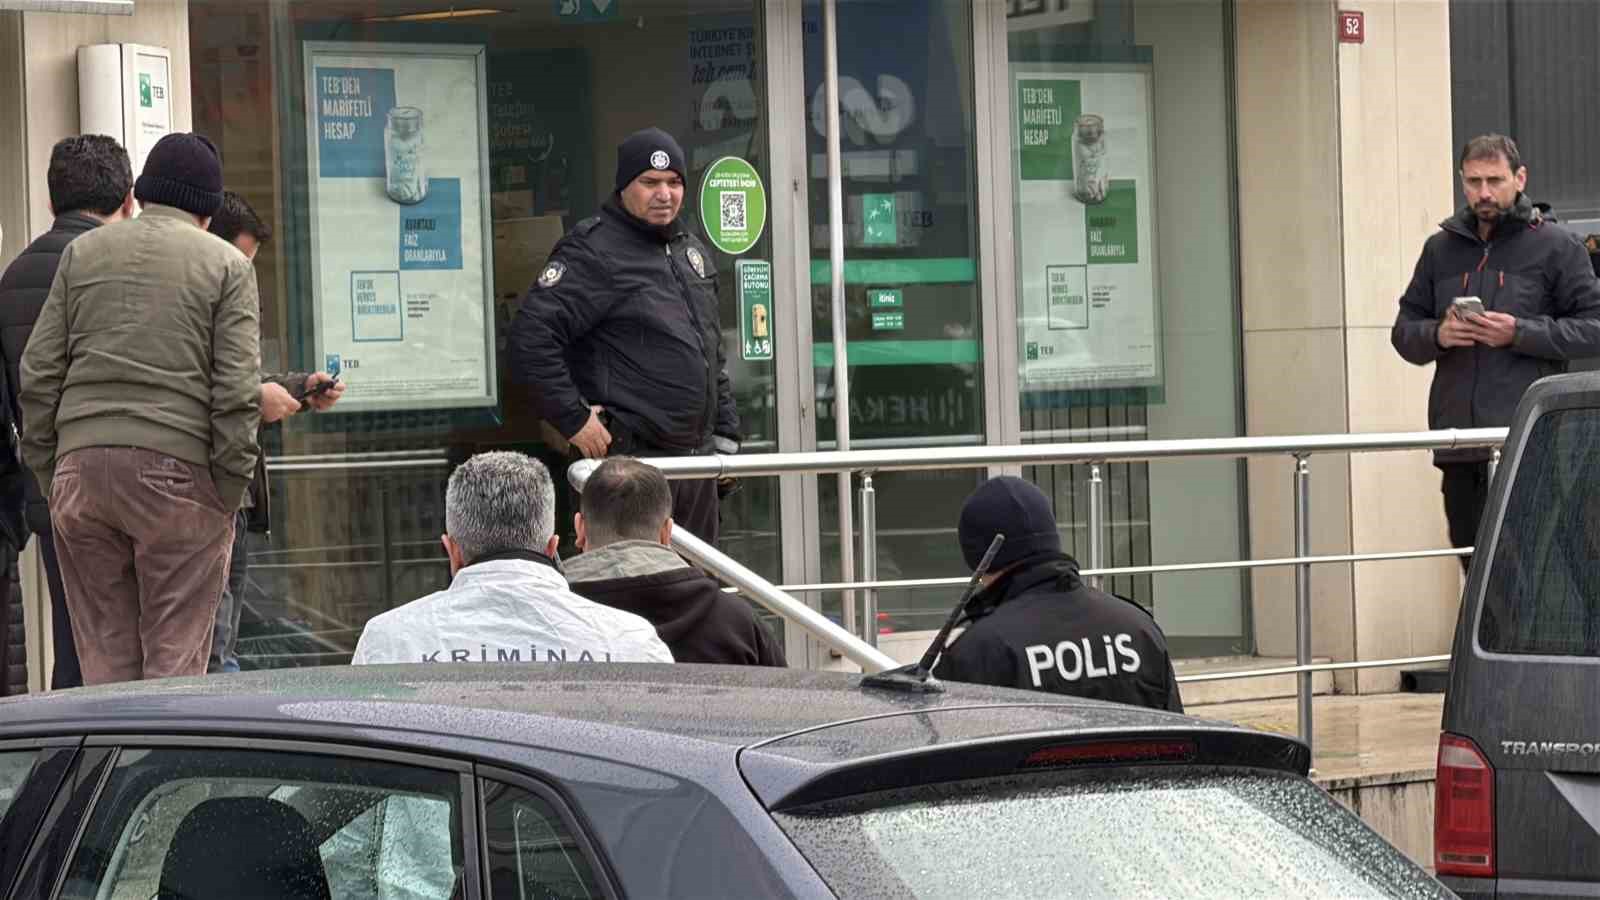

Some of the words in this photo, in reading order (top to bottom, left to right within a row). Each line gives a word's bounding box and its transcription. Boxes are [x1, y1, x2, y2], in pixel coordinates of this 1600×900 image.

[1346, 18, 1359, 35] 52
[152, 86, 165, 99] TEB
[322, 76, 360, 95] TEB'DEN
[1023, 87, 1053, 104] TEB'DEN
[322, 96, 372, 117] MARİFETLİ
[1023, 105, 1063, 125] MARİFETLİ
[324, 122, 356, 140] HESAP
[1024, 129, 1049, 145] HESAP
[743, 281, 769, 289] BUTONU
[343, 359, 360, 369] TEB
